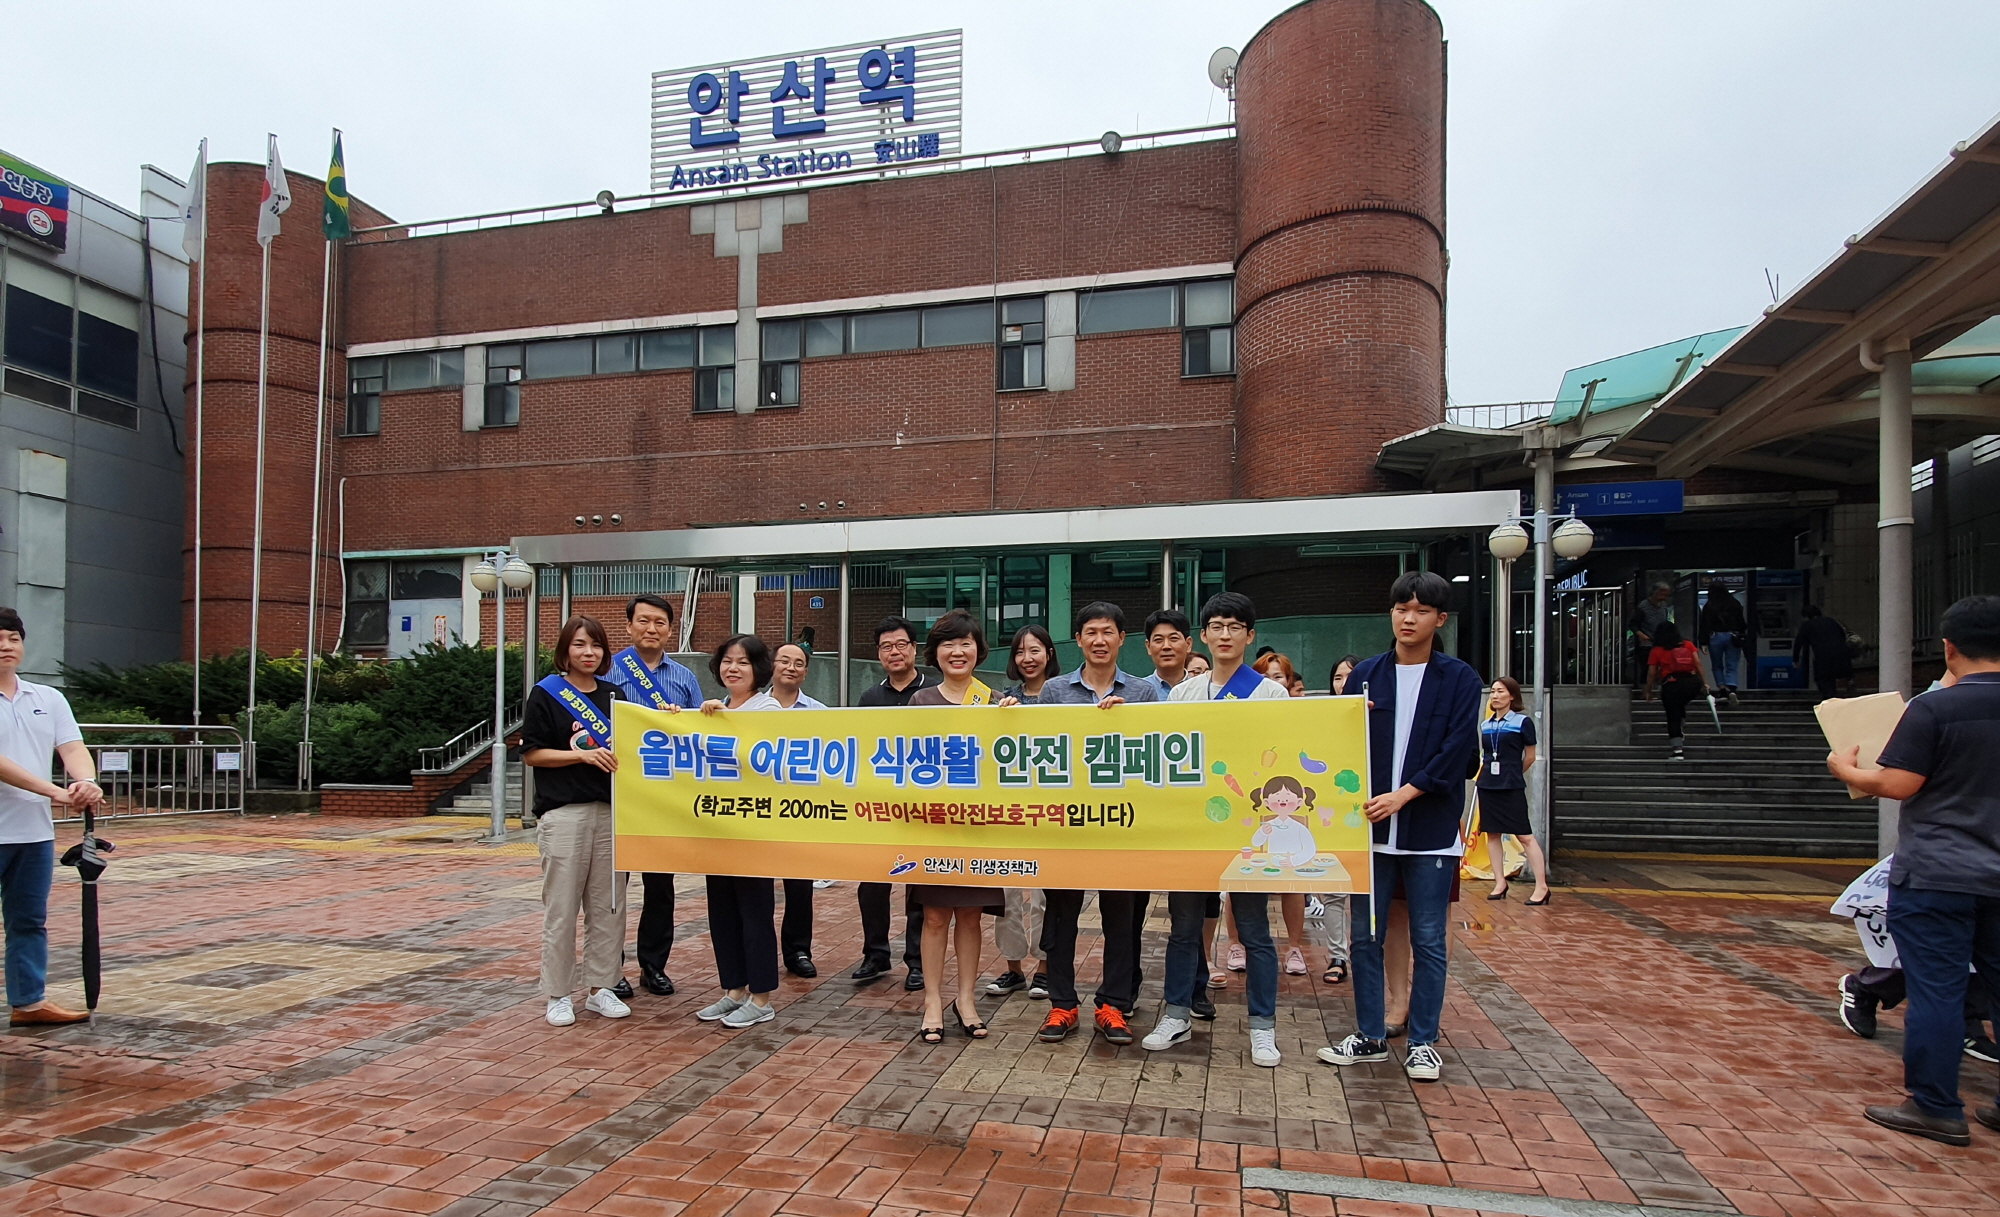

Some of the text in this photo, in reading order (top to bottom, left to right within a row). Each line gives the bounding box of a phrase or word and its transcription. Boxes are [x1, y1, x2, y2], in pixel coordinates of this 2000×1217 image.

[688, 46, 916, 149] 안산역
[874, 132, 940, 164] 安山驛
[0, 167, 53, 205] 연습장
[669, 149, 853, 190] Ansan Station
[1567, 491, 1589, 499] Ansan
[559, 688, 608, 734] 불법영업
[638, 729, 1202, 786] 올바른 어린이 식생활 안전 캠페인
[693, 794, 1135, 827] (학교주변 200m는 어린이식품안전보호구역입니다)
[923, 857, 1038, 876] 안산시 위생정책과
